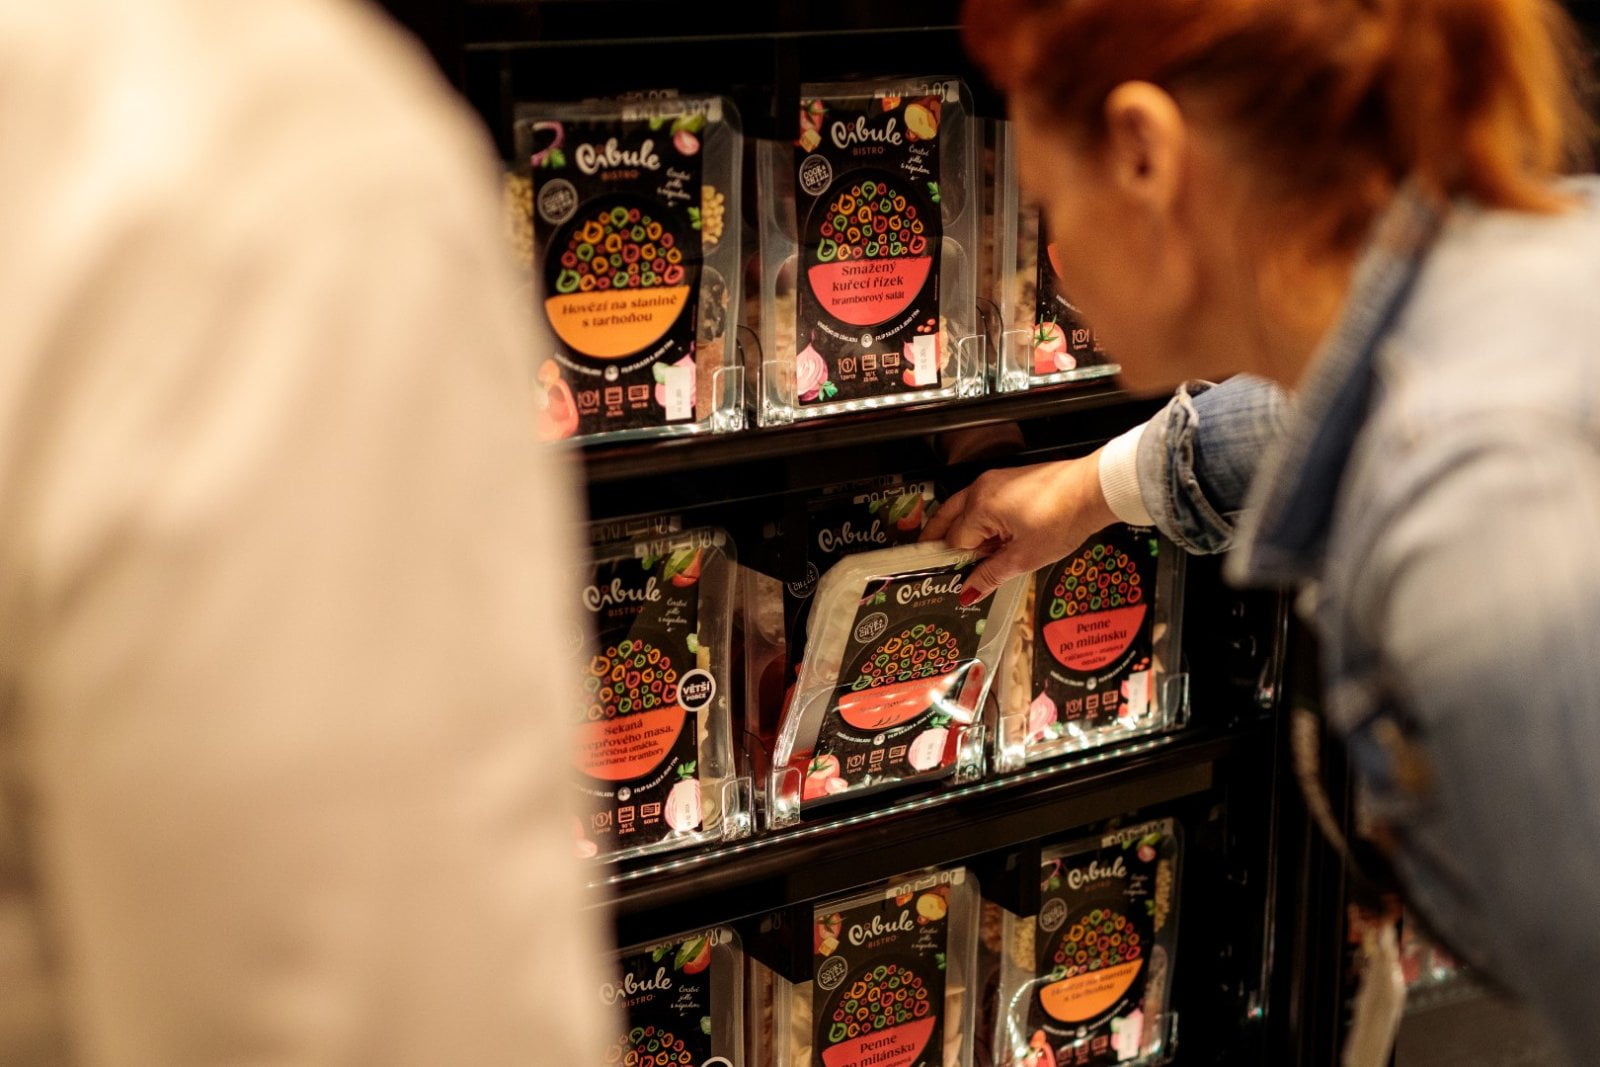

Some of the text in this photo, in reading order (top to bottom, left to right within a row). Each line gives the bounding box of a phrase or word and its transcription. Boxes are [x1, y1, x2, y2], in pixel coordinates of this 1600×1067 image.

[831, 115, 903, 149] Cibule
[575, 137, 661, 175] Cibule
[853, 146, 884, 156] BISTRO
[842, 261, 897, 276] Smažený
[832, 275, 904, 292] kuřecí řízek
[562, 294, 677, 315] Hovězí na slanině
[832, 291, 905, 305] bramborový salát
[818, 520, 887, 552] Cibule
[582, 577, 661, 612] Cibule
[896, 574, 963, 605] Cibule
[608, 606, 643, 617] BISTRO
[913, 597, 943, 608] BISTRO
[1077, 619, 1111, 634] Penne
[1060, 630, 1127, 655] po milánsku
[682, 681, 710, 695] VĚTŠÍ
[605, 719, 643, 735] Sekaná
[579, 733, 642, 752] epřového
[1068, 856, 1127, 890] Cibule
[849, 909, 914, 946] Cibule
[867, 935, 897, 949] BISTRO
[860, 1035, 897, 1053] Penne
[861, 1043, 915, 1067] milánsku
